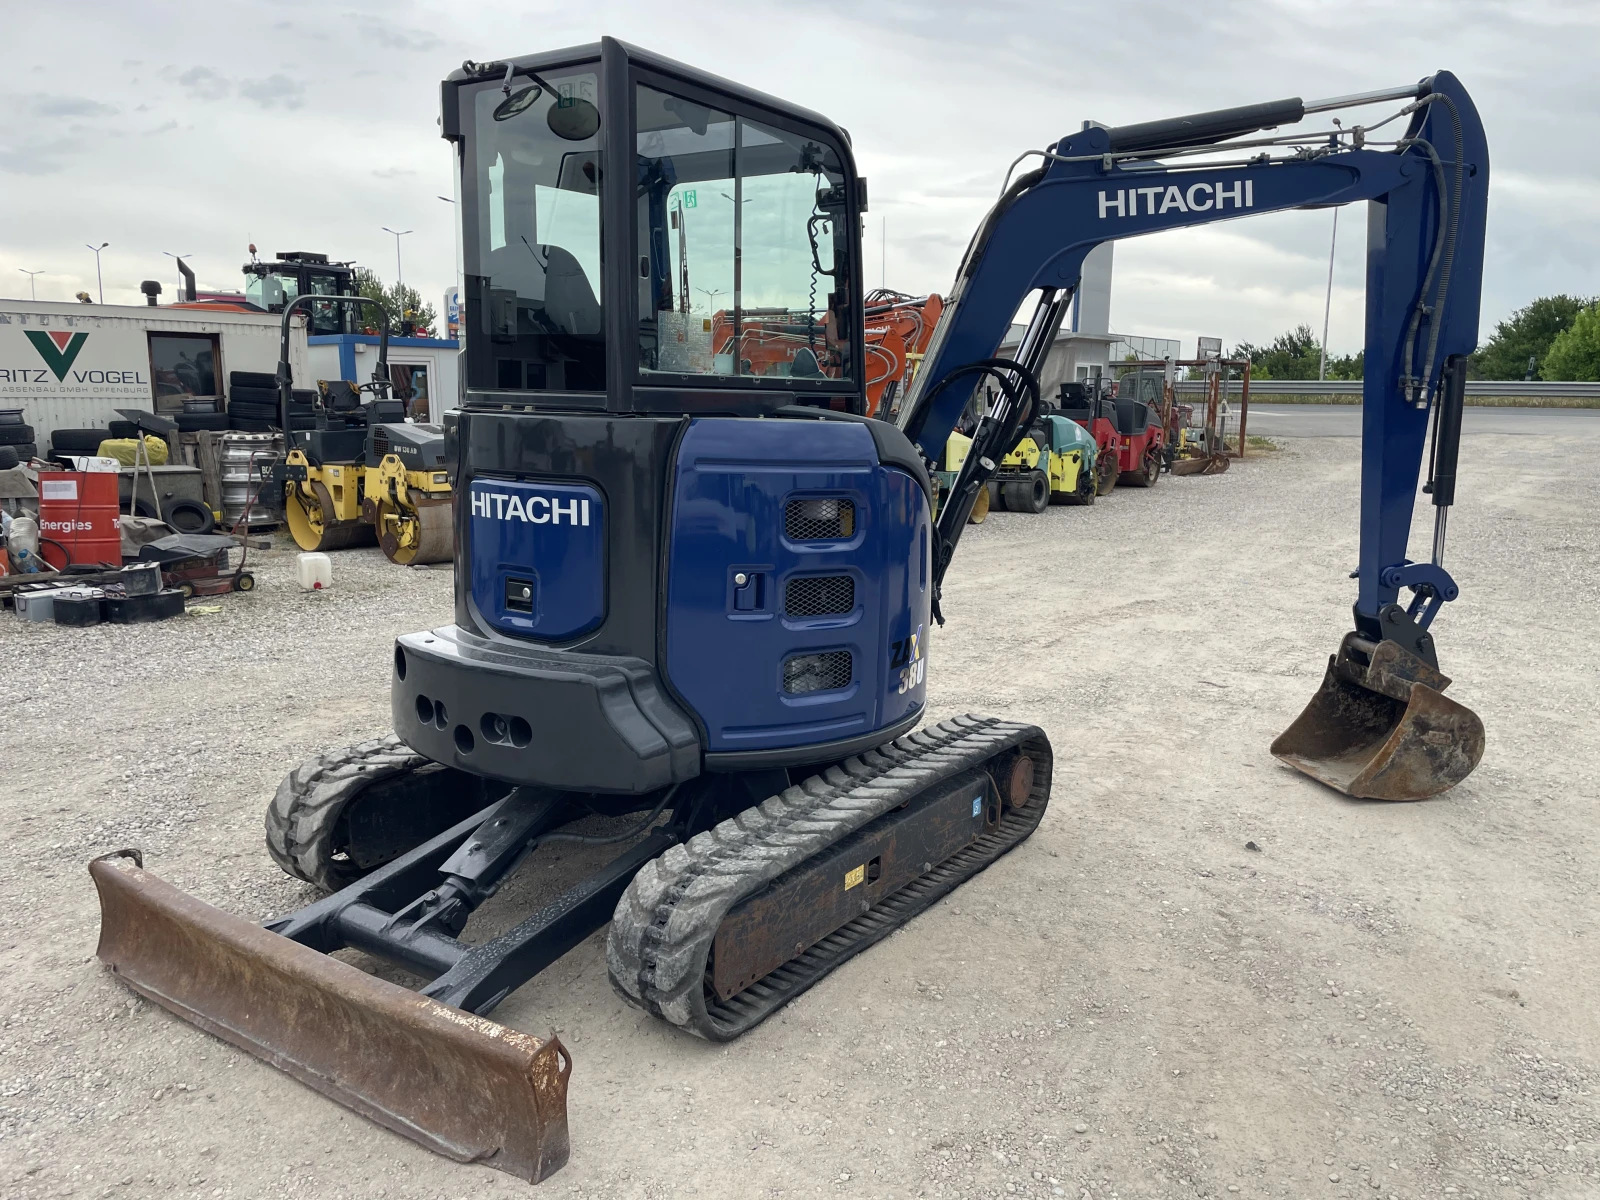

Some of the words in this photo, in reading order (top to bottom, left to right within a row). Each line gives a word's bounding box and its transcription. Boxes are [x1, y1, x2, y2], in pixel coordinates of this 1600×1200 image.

[1098, 180, 1253, 218] HITACHI
[73, 370, 147, 384] VOGEL
[40, 519, 92, 533] Energies
[471, 491, 589, 526] HITACHI
[891, 624, 922, 669] ZAX
[899, 657, 924, 694] 38U
